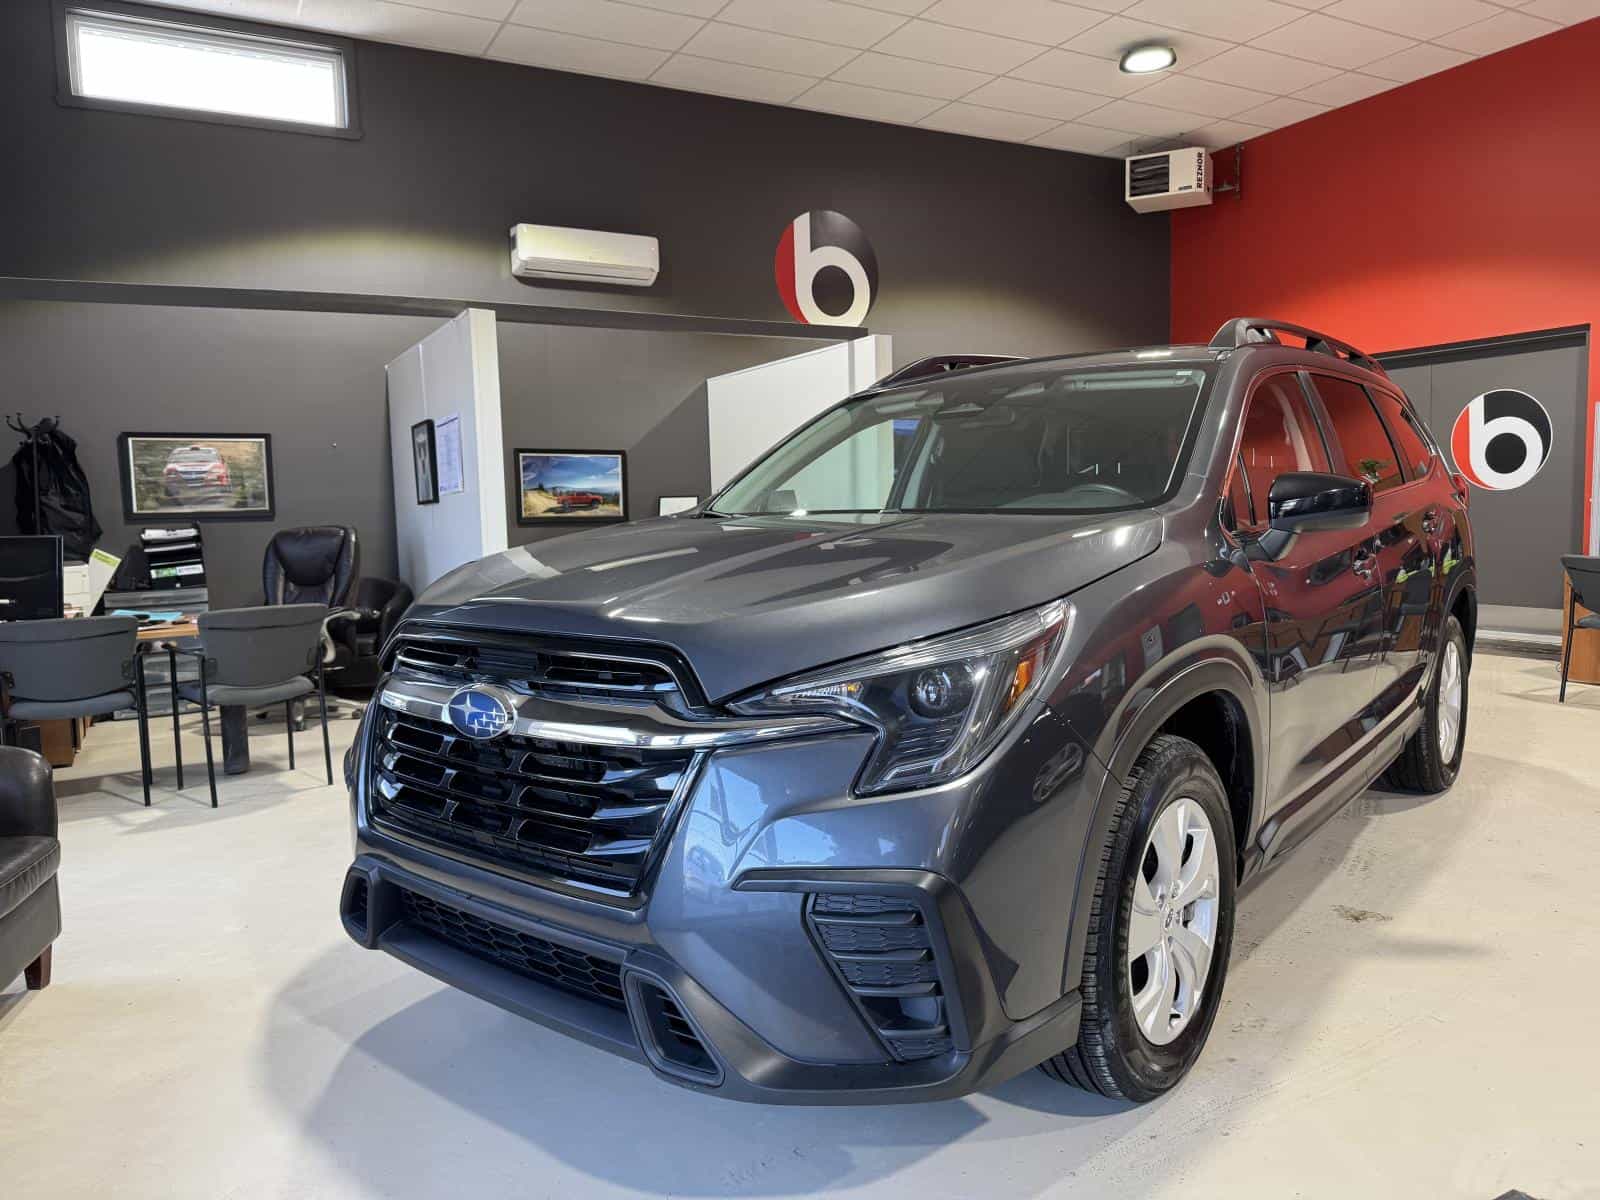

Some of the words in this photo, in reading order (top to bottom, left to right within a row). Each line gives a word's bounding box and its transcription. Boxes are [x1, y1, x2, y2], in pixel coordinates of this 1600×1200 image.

[1196, 151, 1204, 189] REZNOR
[793, 211, 871, 327] b
[1469, 394, 1544, 490] b
